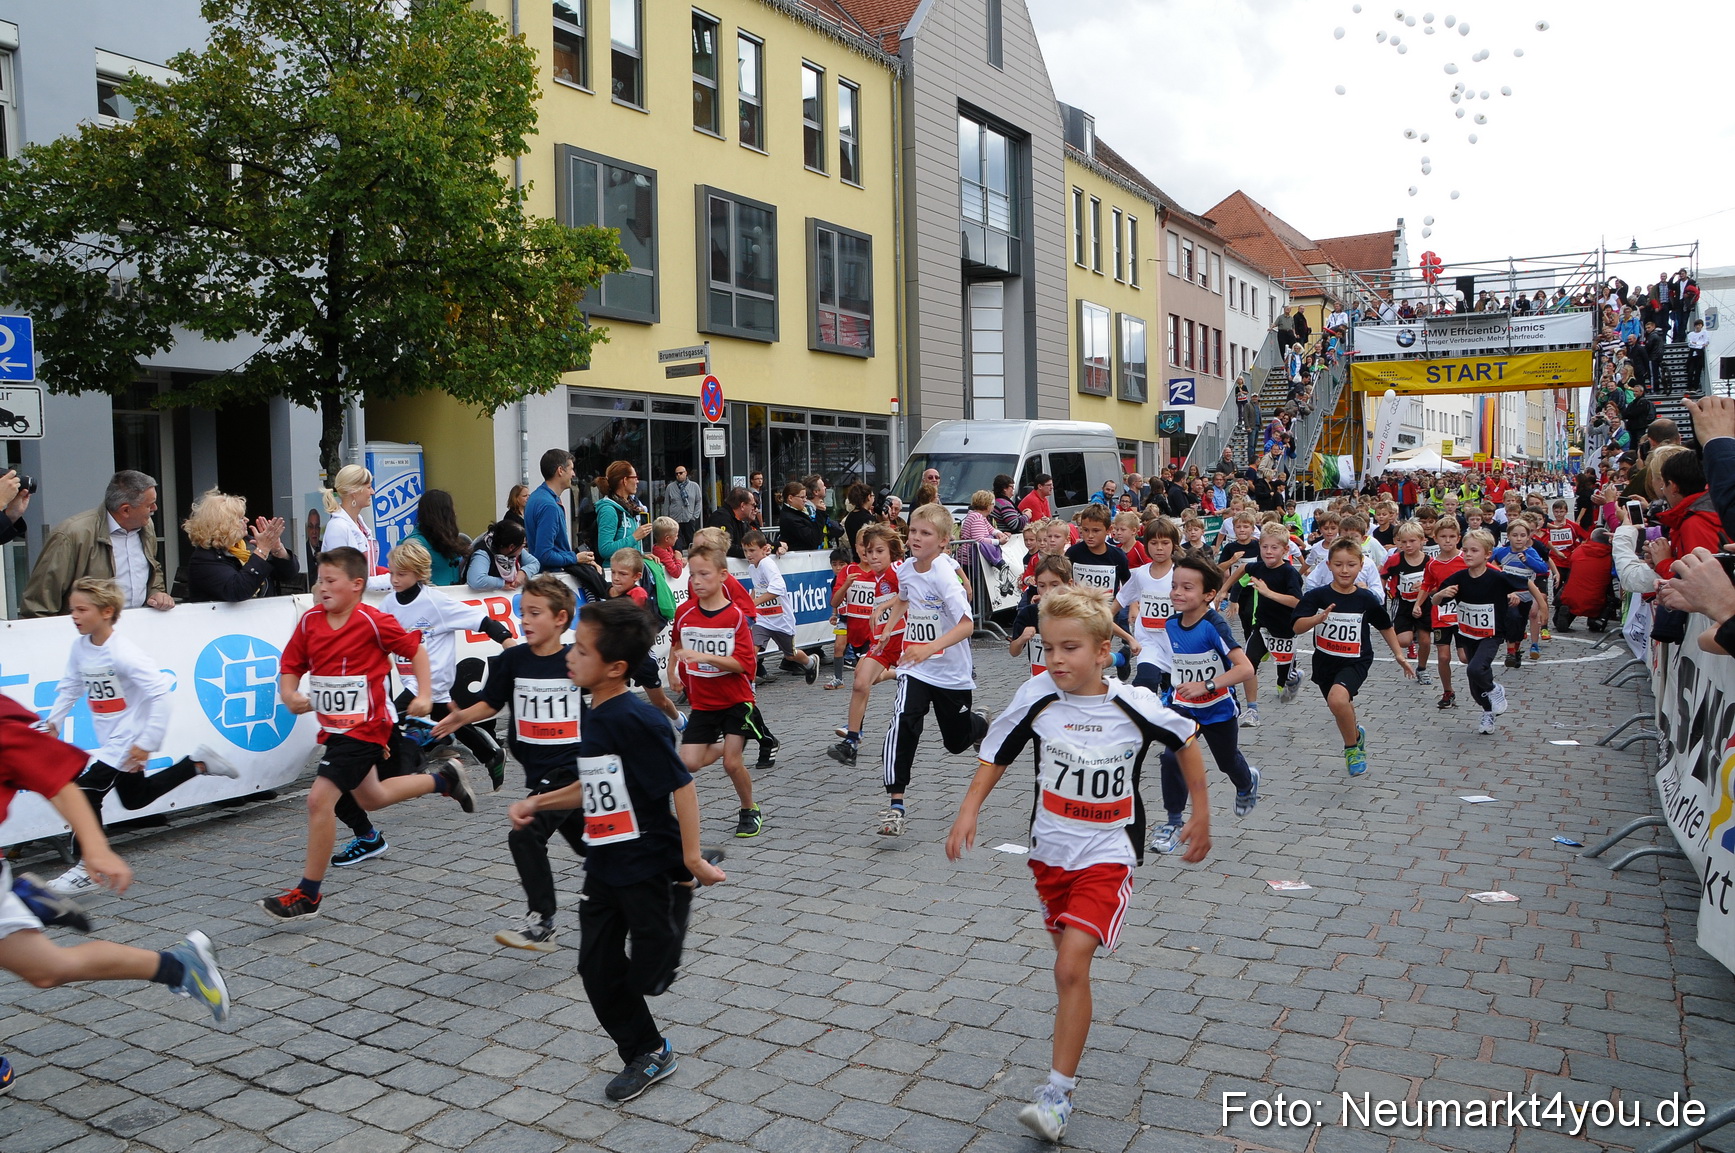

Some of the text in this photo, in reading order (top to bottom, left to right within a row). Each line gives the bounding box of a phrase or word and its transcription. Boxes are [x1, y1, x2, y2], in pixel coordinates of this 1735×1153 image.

[1421, 323, 1545, 338] BMW EfficientDynamics
[1421, 332, 1546, 346] Weniger Verbrauch. Mehr Fahrfreude.
[660, 348, 704, 360] Brunnwirtsgasse
[1426, 362, 1508, 384] START
[1402, 581, 1414, 593] 72
[851, 589, 874, 605] 708
[1460, 609, 1489, 627] 7113
[906, 622, 936, 641] 7300
[1321, 622, 1357, 642] 7205
[313, 690, 358, 712] 7097
[519, 694, 569, 719] 7111
[532, 725, 557, 736] Timo
[1046, 745, 1122, 767] PARTL Neumarkt
[1053, 760, 1125, 799] 7108
[1064, 802, 1112, 820] Fabian
